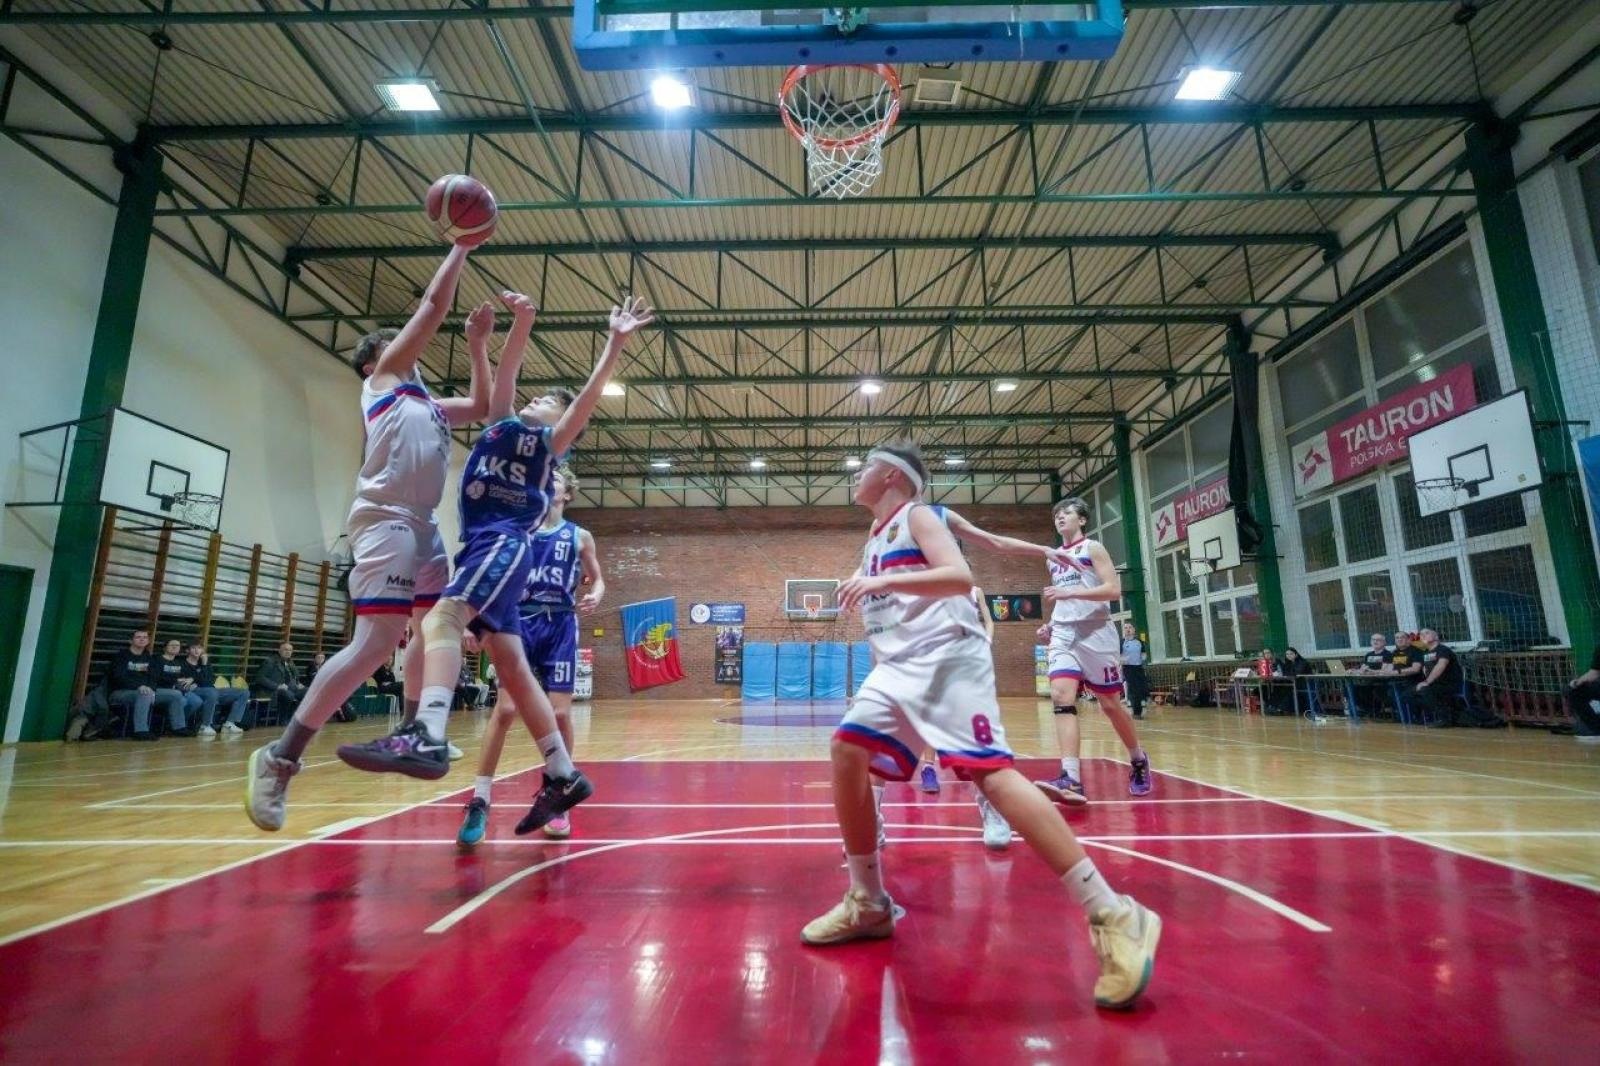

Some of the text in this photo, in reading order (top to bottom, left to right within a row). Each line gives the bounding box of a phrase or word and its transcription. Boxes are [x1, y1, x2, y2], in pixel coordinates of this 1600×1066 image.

[1340, 384, 1455, 453] TAURON
[516, 433, 538, 457] 13
[1350, 441, 1395, 468] POLSKA
[1177, 483, 1231, 519] TAURON
[554, 661, 571, 683] 51
[970, 714, 993, 746] 8
